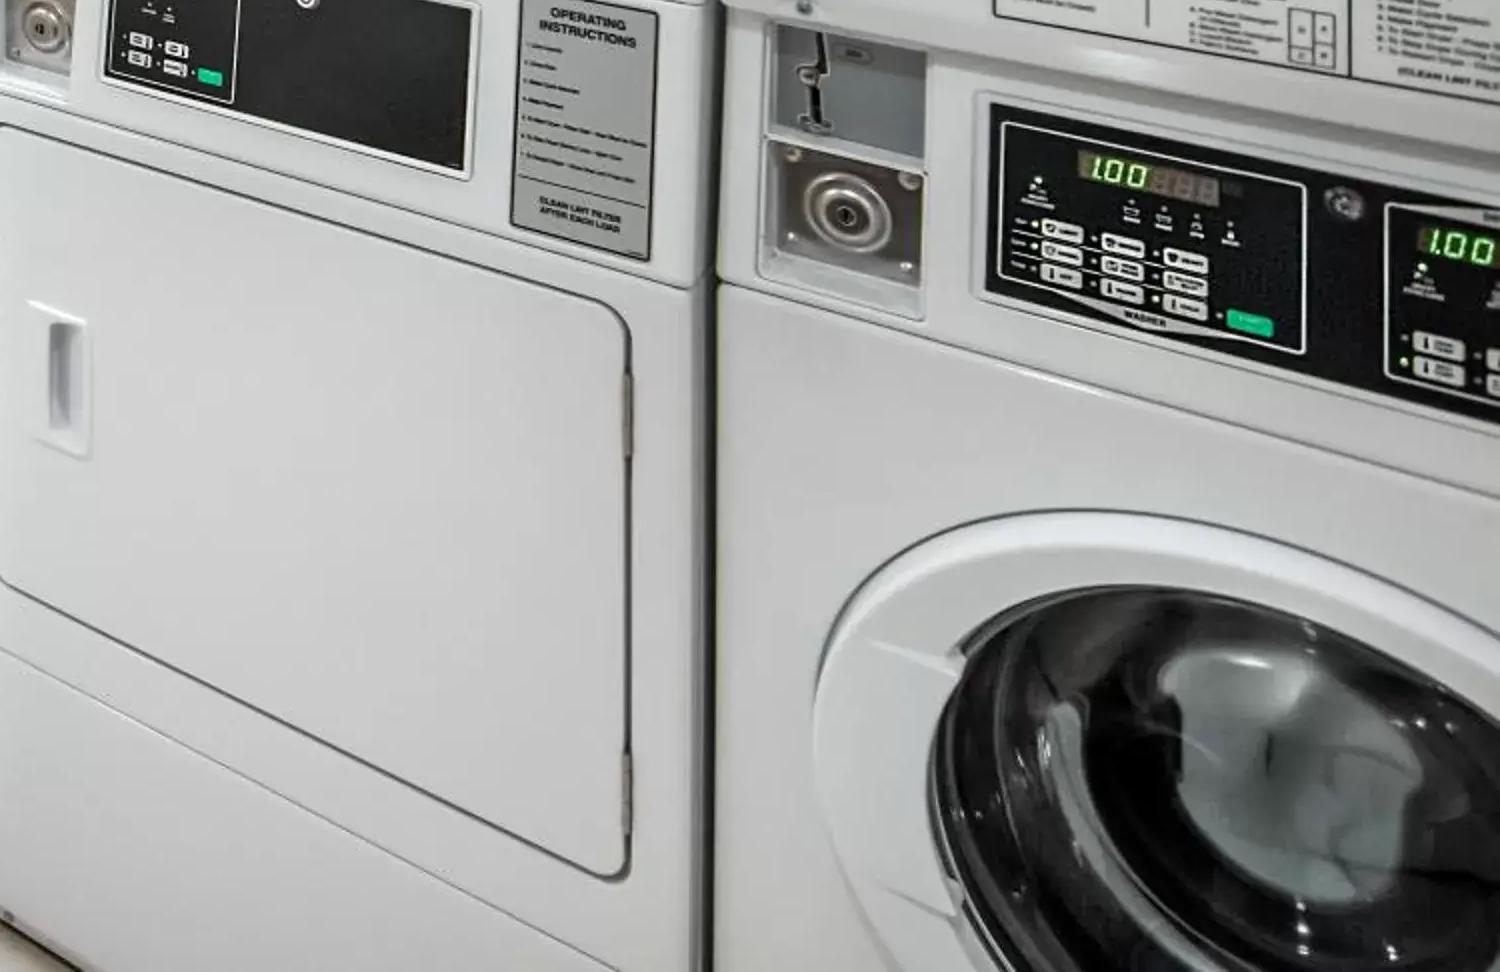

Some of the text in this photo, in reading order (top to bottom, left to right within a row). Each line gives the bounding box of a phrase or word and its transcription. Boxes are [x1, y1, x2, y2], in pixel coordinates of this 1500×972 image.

[550, 7, 626, 31] OPERATING
[539, 19, 636, 48] INSTRUCTIONS
[1429, 229, 1495, 265] 1.00
[1123, 309, 1167, 327] WASHER
